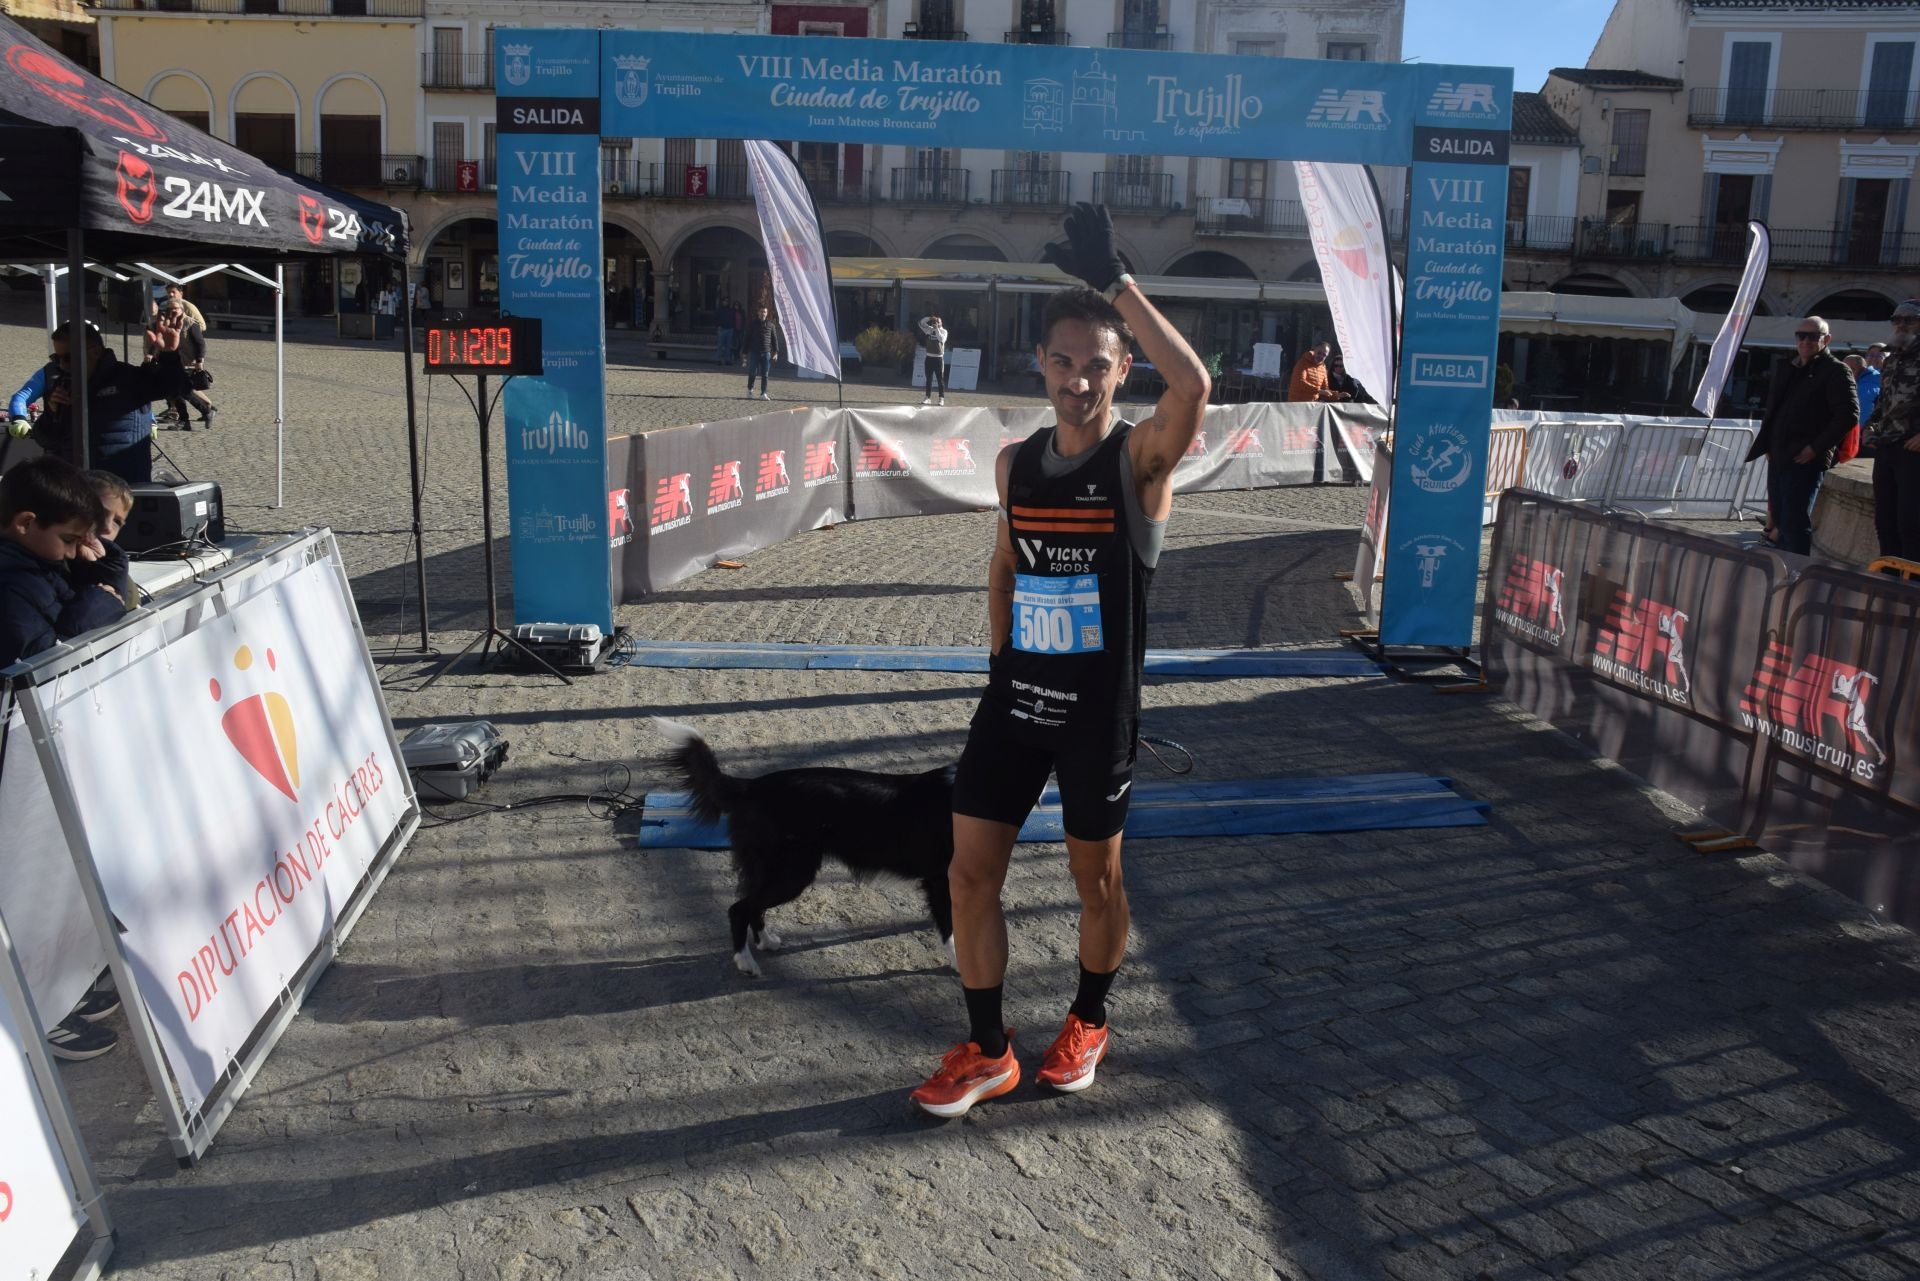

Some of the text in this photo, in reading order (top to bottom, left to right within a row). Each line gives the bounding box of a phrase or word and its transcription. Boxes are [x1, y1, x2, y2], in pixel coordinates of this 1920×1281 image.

[535, 57, 582, 67] Ayuntamiento
[536, 66, 572, 76] Trujillo
[737, 55, 1003, 86] VIII Media Maratón
[654, 72, 725, 84] Ayuntamiento de
[654, 83, 701, 97] Trujillo
[770, 82, 981, 120] Ciudad de Trujillo
[1147, 73, 1263, 129] Trujillo
[513, 108, 584, 125] SALIDA
[808, 115, 937, 130] Juan Mateos Broncano
[1426, 110, 1497, 120] www.musicrun.es
[1305, 120, 1387, 131] www.musicrun.es
[1429, 137, 1495, 156] SALIDA
[515, 151, 577, 176] VIII
[512, 185, 588, 203] Media
[1428, 178, 1485, 204] VIII
[163, 176, 270, 228] 24MX
[506, 212, 594, 230] Maratón
[1422, 210, 1493, 230] Media
[518, 237, 582, 251] Ciudad de
[1416, 236, 1497, 255] Maratón
[507, 253, 593, 288] Trujillo
[1424, 259, 1484, 275] Ciudad de
[1414, 275, 1492, 309] Trujillo
[1421, 363, 1477, 379] HABLA
[1408, 423, 1468, 456] Club Atletismo
[804, 473, 838, 488] www.musicrun.es
[856, 468, 910, 478] www.musicrun.es
[755, 485, 789, 501] www.musicrun.es
[707, 498, 742, 516] www.musicrun.es
[553, 513, 597, 533] Trujillo
[650, 514, 691, 536] www.musicrun.es
[1046, 547, 1096, 562] VICKY
[1050, 562, 1090, 573] FOODS
[1020, 605, 1073, 651] 500
[1495, 607, 1560, 647] www.musicrun.es
[1592, 653, 1687, 704] www.musicrun.es
[1742, 711, 1876, 780] www.musicrun.es
[177, 752, 384, 1023] DIPUTACIÓN DE CÁCERES
